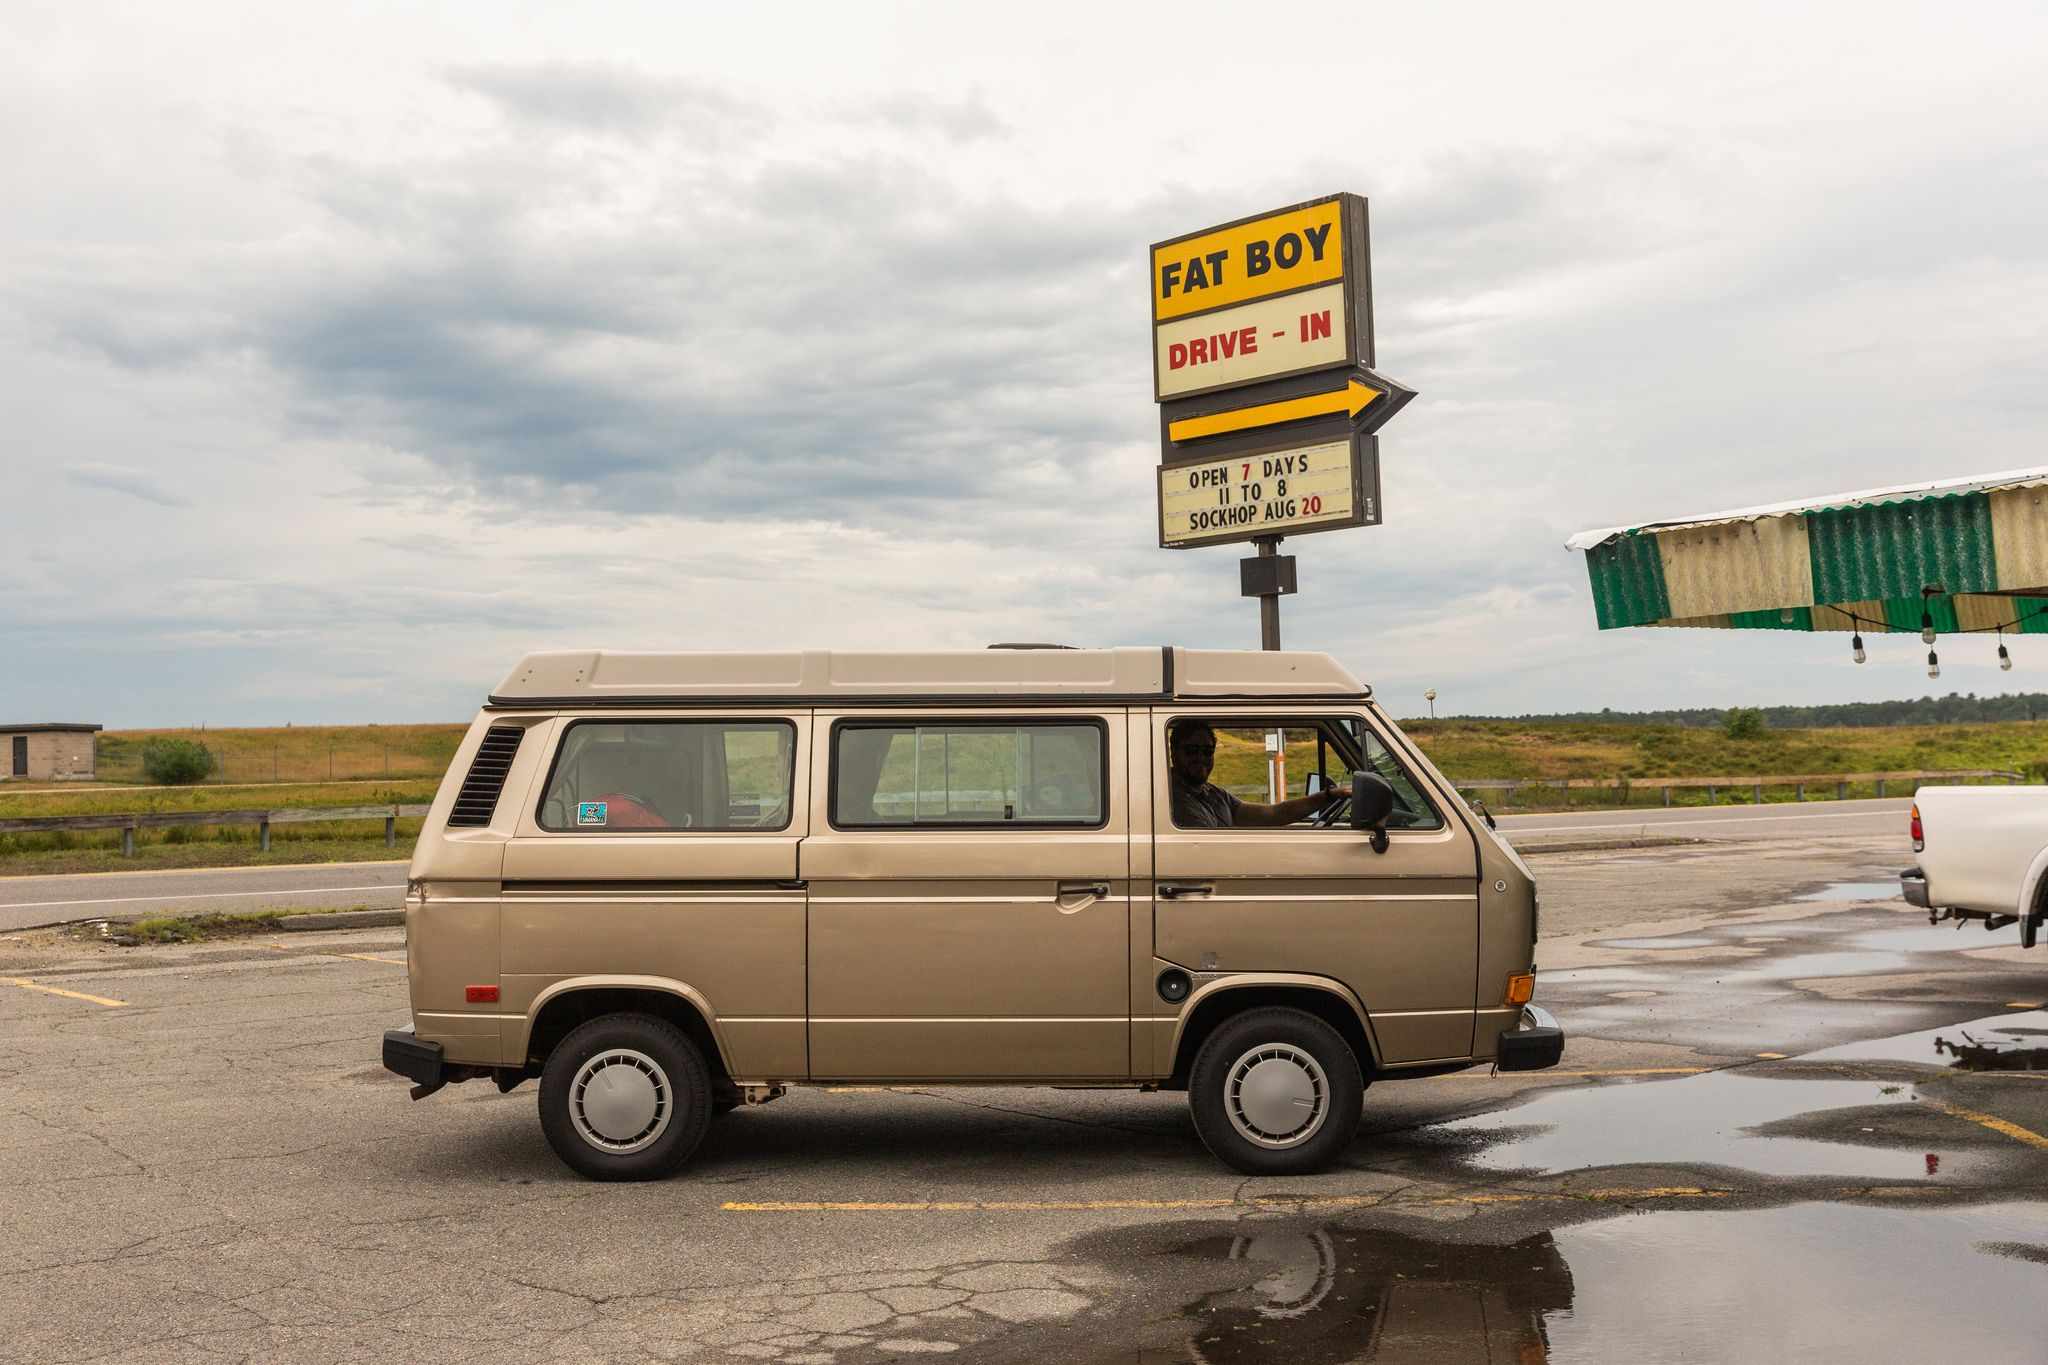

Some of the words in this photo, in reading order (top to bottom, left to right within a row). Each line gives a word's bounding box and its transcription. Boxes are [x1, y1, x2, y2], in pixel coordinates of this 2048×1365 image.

[1162, 250, 1228, 299] FAT
[1246, 223, 1332, 278] BOY
[1169, 326, 1258, 370] DRIVE
[1300, 310, 1332, 343] IN
[1189, 466, 1228, 489] OPEN
[1242, 463, 1250, 481] 7
[1263, 454, 1308, 478] DAYS
[1241, 482, 1261, 502] TO
[1277, 479, 1287, 497] 8
[1190, 504, 1257, 530] SOCKHOP
[1264, 499, 1296, 521] AUG
[1302, 495, 1322, 516] 20
